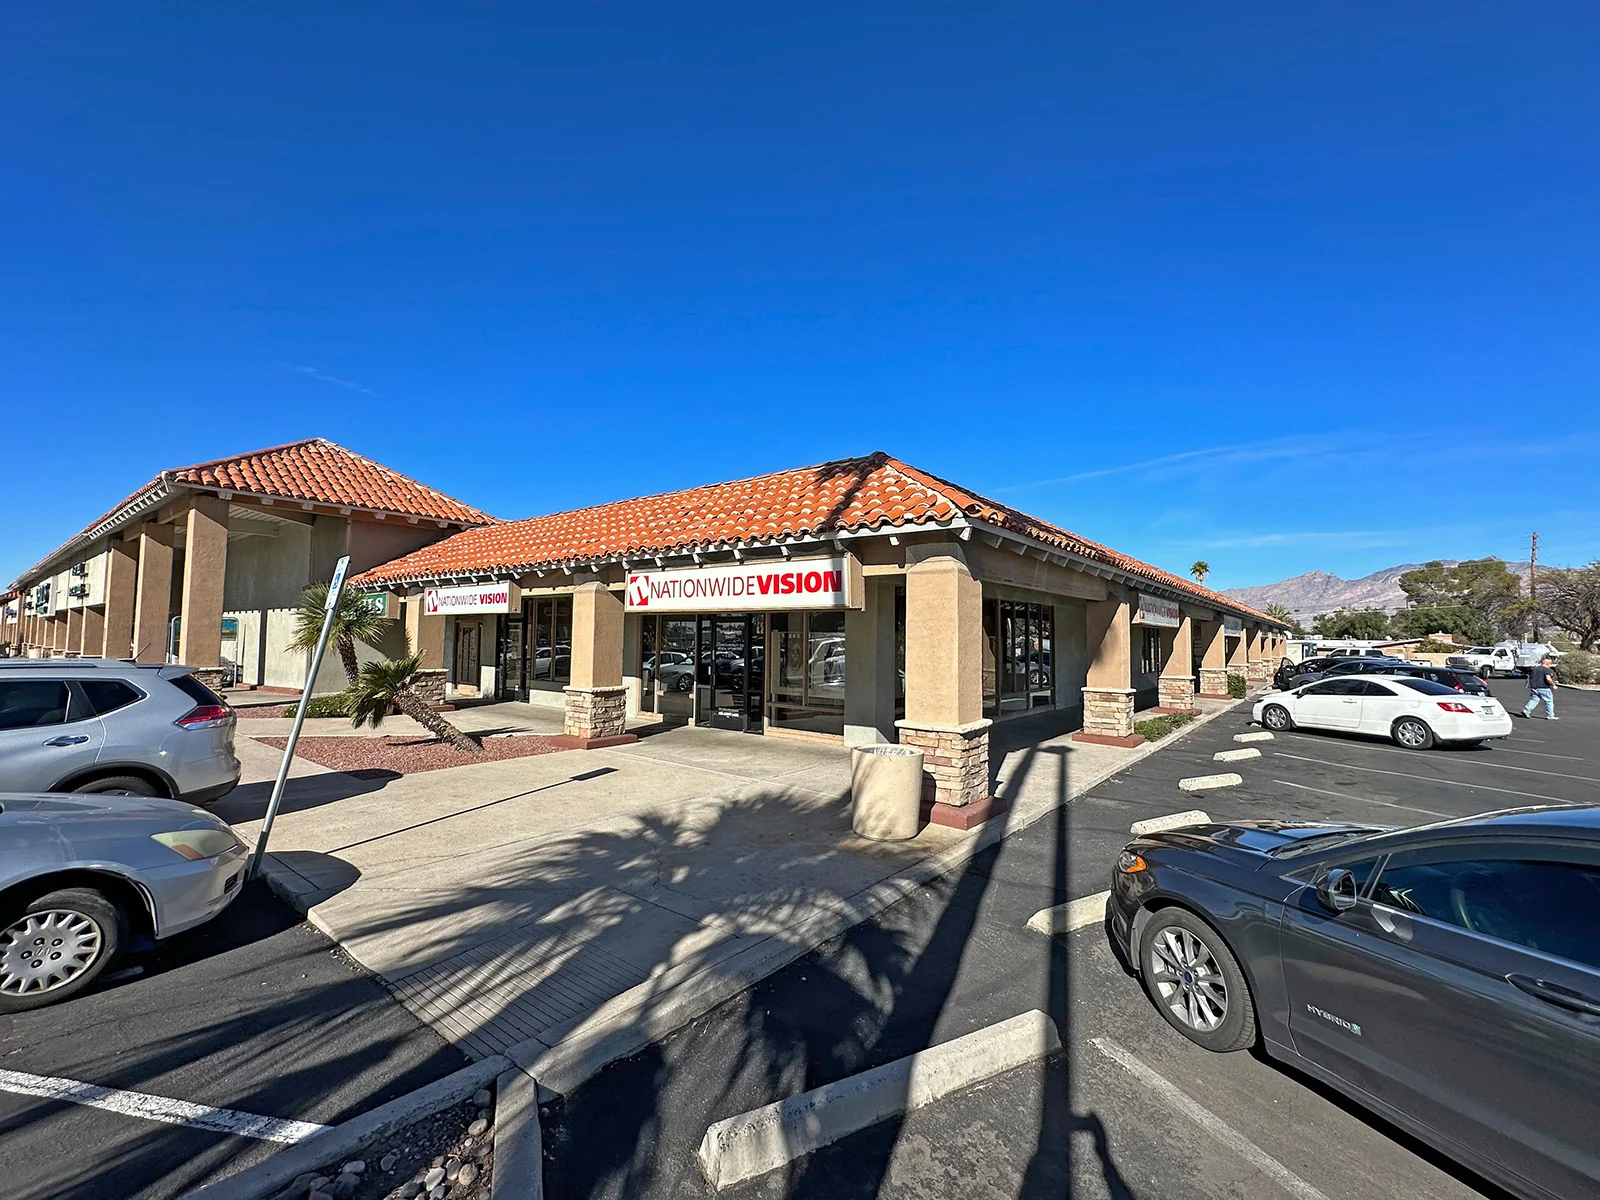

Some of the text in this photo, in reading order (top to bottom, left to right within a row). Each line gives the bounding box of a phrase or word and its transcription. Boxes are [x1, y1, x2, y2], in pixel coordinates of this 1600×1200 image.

[438, 594, 478, 607] NATIONWIDE
[479, 592, 508, 605] VISION
[1306, 1003, 1351, 1031] HYBRID
